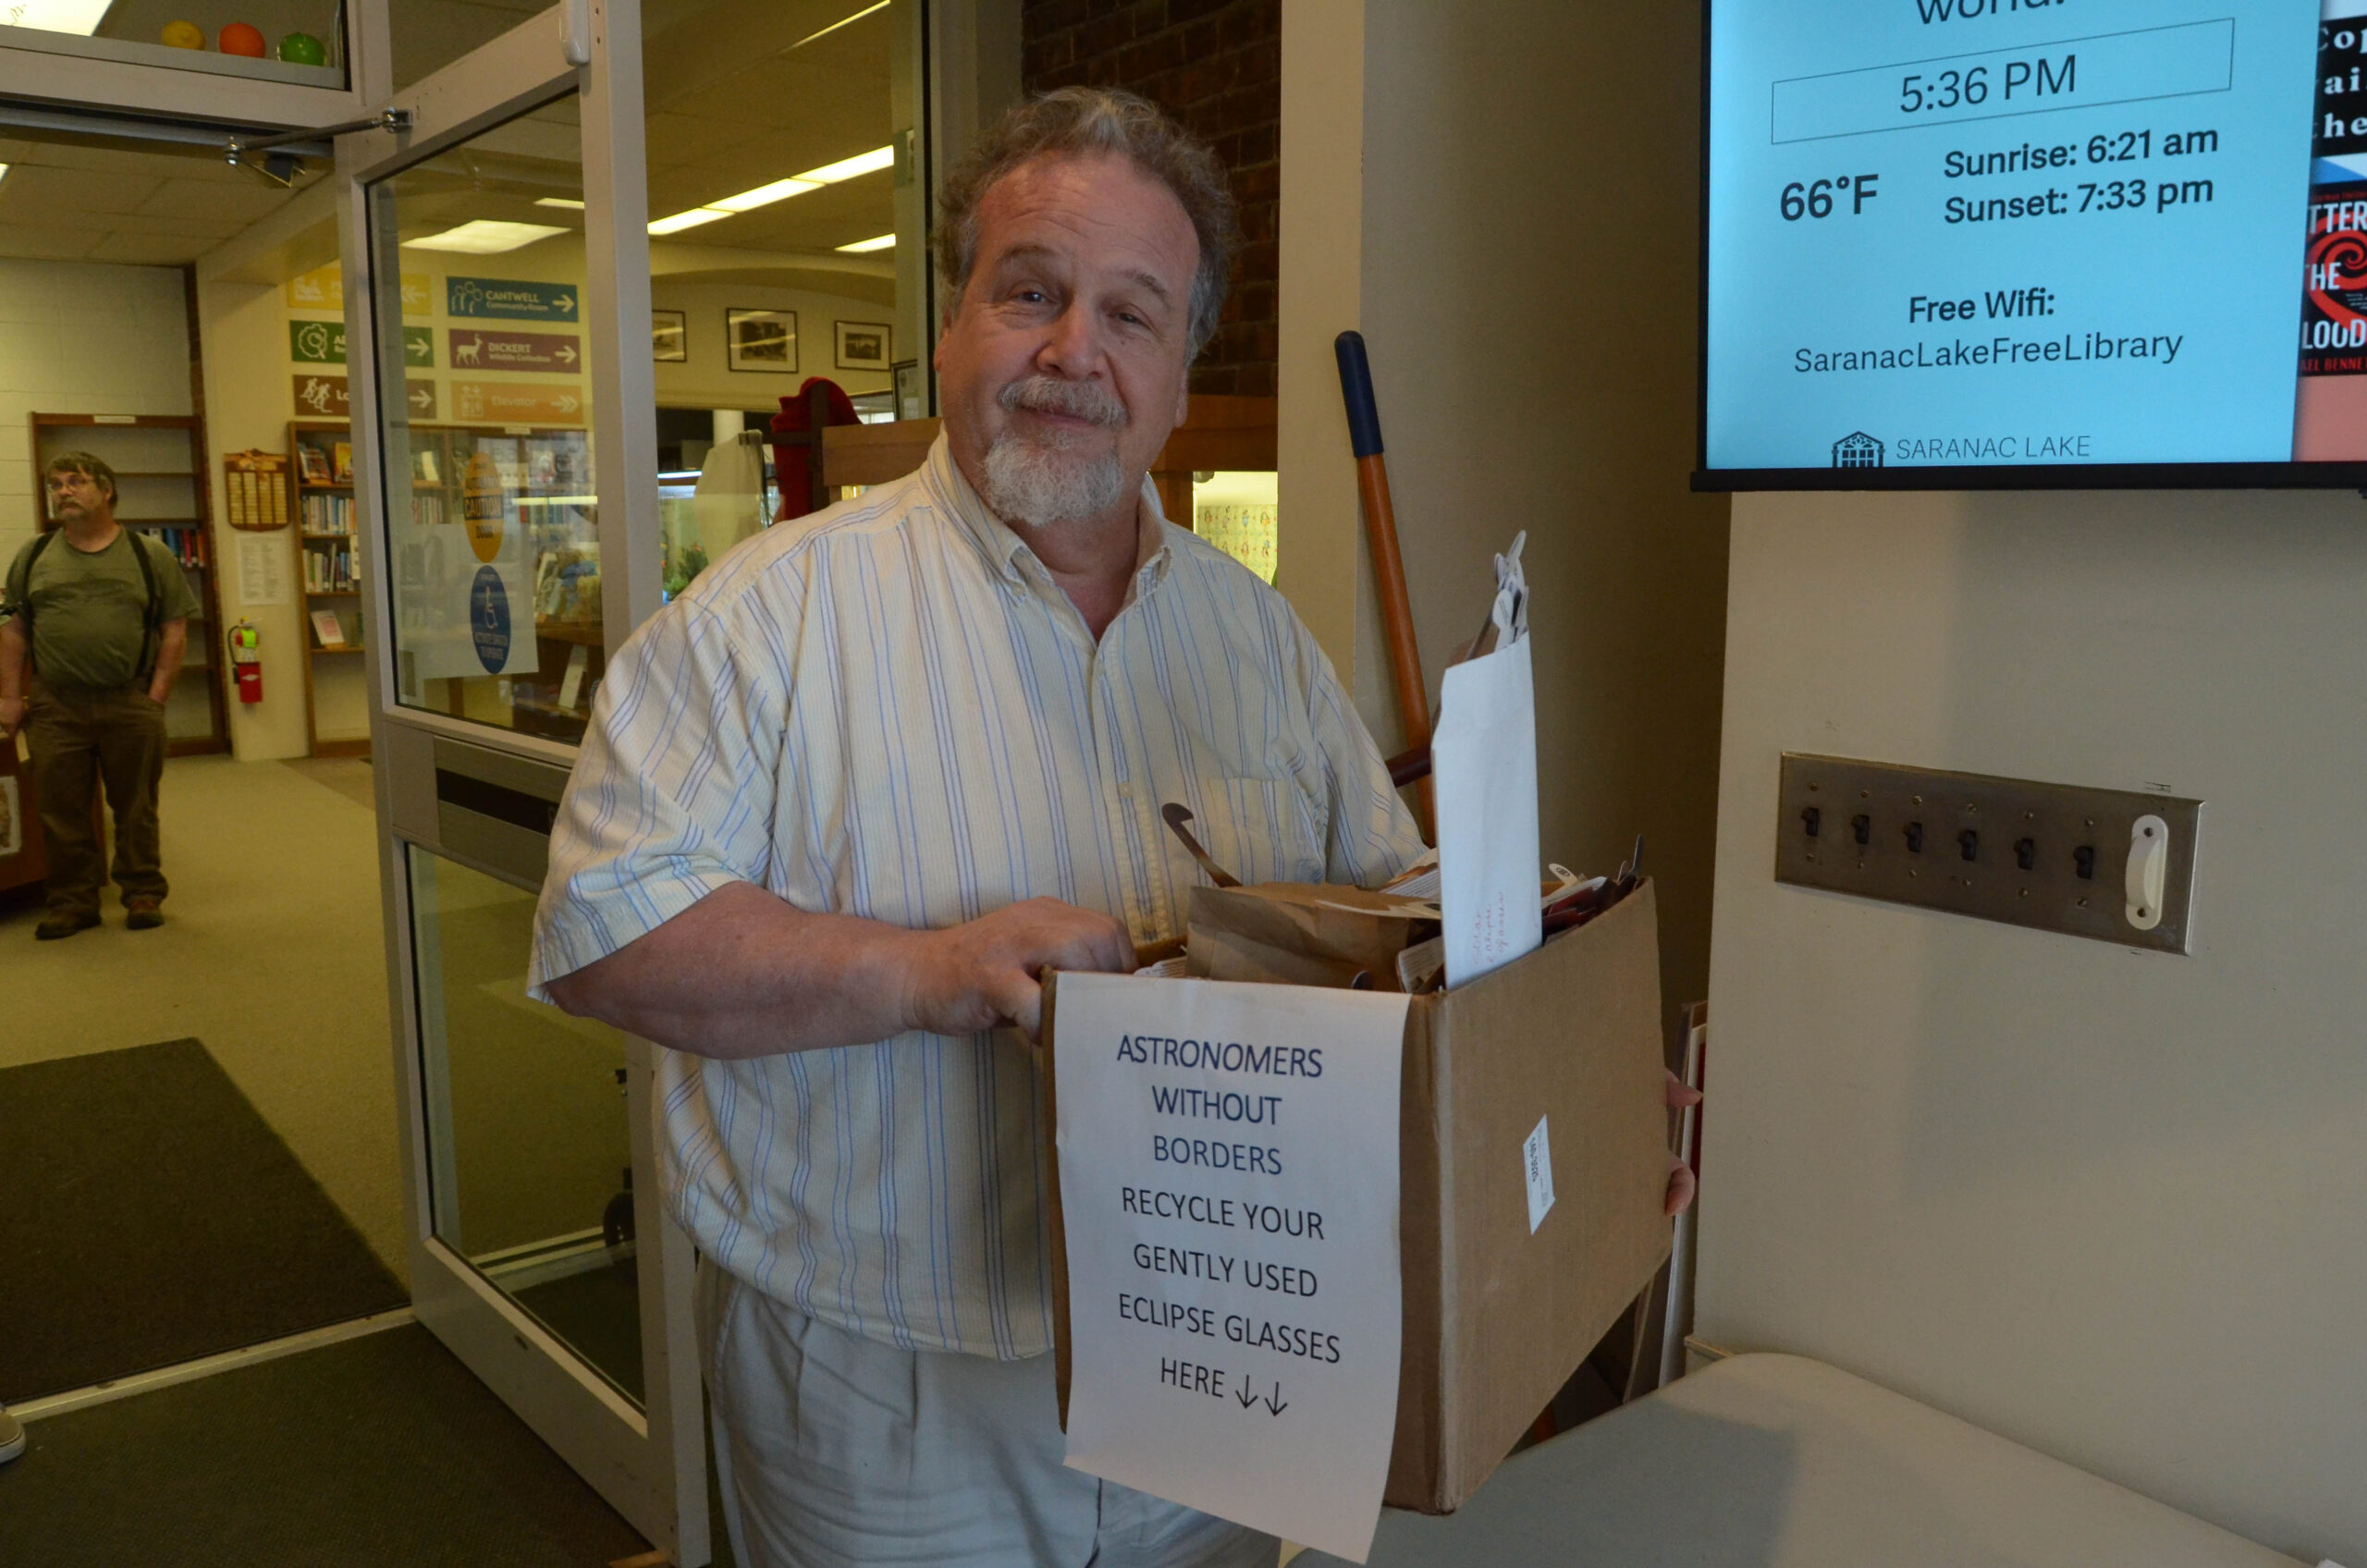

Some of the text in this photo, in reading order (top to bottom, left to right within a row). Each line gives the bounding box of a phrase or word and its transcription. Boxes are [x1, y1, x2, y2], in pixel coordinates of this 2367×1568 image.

[1900, 54, 2076, 113] 5:36 PM
[1944, 129, 2218, 178] Sunrise: 6:21 am
[1780, 173, 1879, 222] 66°F
[1944, 178, 2214, 224] Sunset: 7:33 pm
[485, 290, 539, 302] CANTWELL
[1909, 287, 2054, 324] Free Wifi:
[488, 342, 532, 353] DICKERT
[1795, 331, 2183, 373] SaranacLakeFreeLibrary
[491, 395, 537, 408] Elevator
[1895, 435, 2091, 460] SARANAC LAKE
[464, 497, 502, 519] CAUTION
[1116, 1035, 1322, 1078] ASTRONOMERS
[1151, 1084, 1282, 1125] WITHOUT
[1153, 1134, 1282, 1176] BORDERS
[1122, 1186, 1324, 1240] RECYCLE YOUR
[1134, 1243, 1318, 1297] GENTLY USED
[1119, 1292, 1341, 1364] ECLIPSE GLASSES
[1160, 1357, 1225, 1399] HERE
